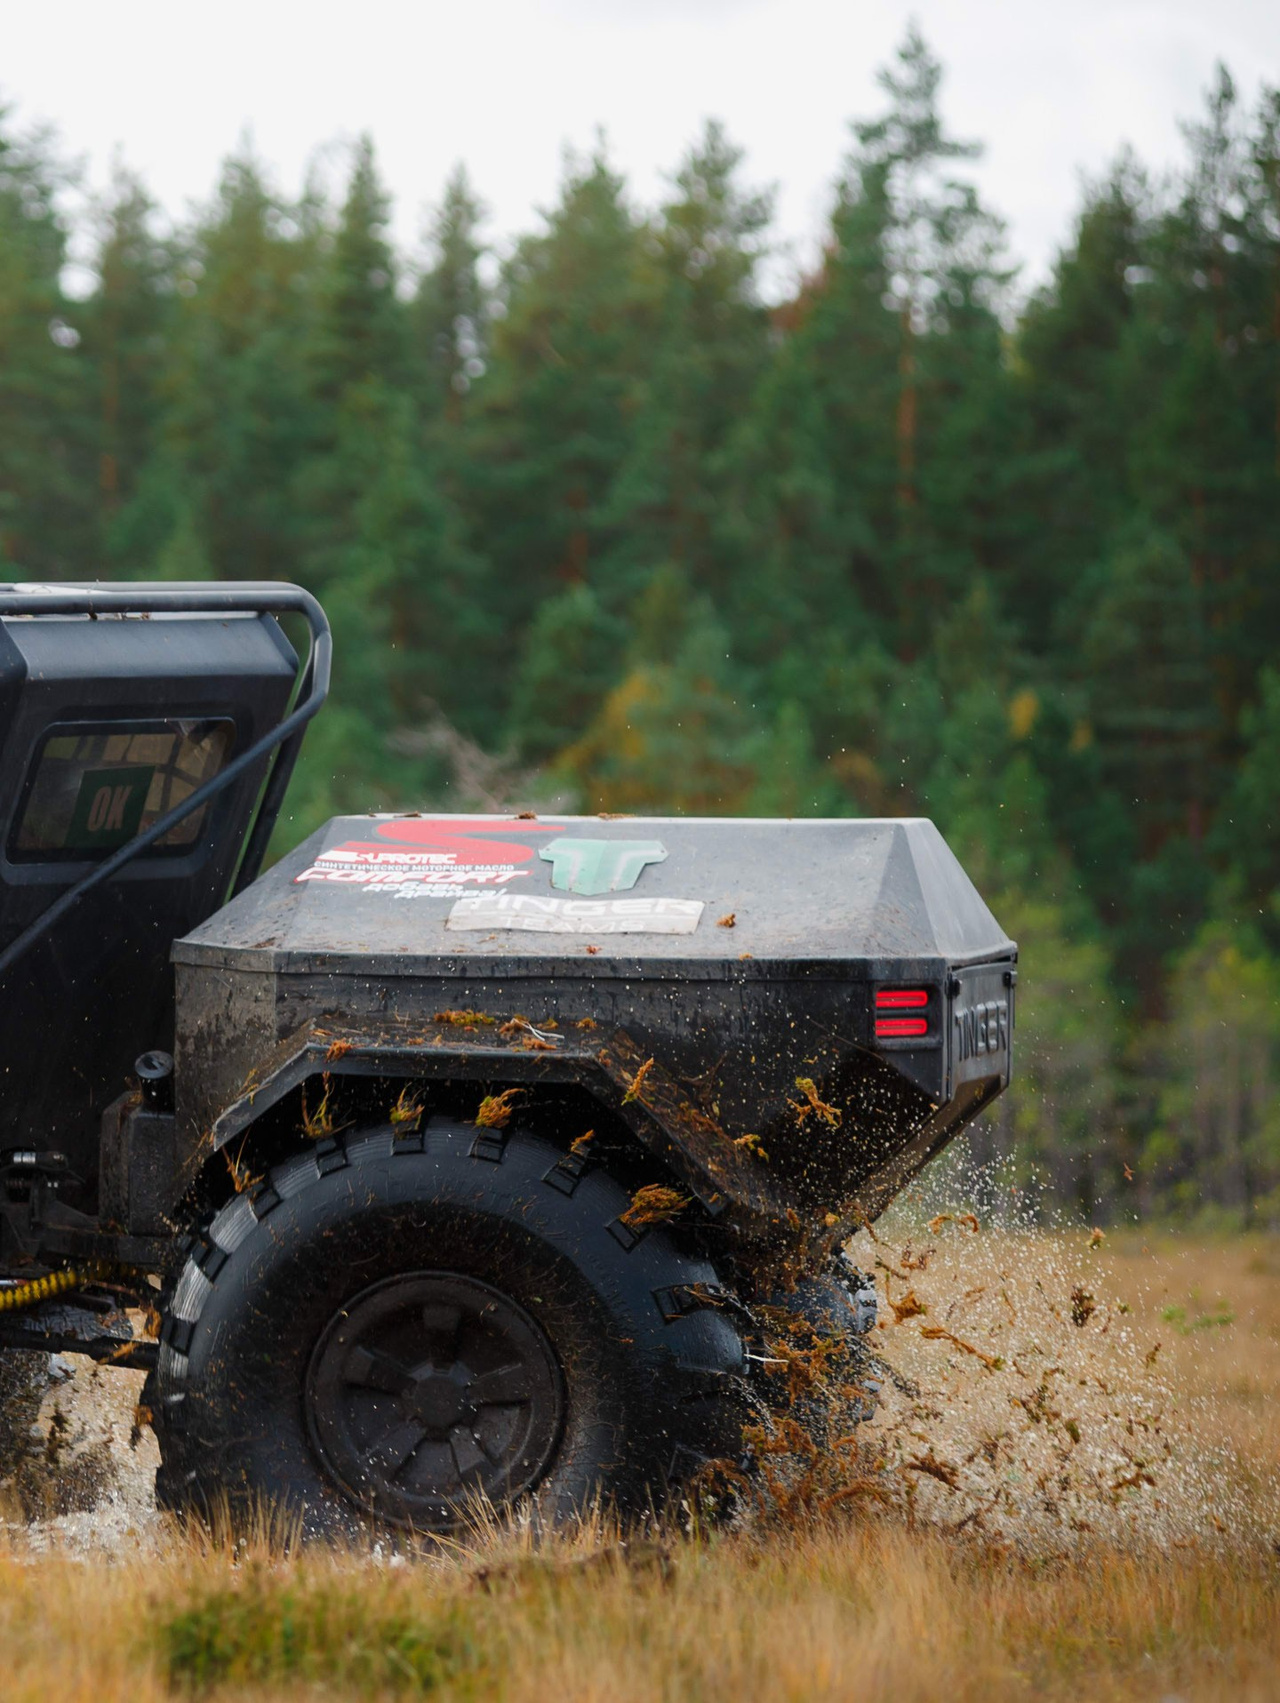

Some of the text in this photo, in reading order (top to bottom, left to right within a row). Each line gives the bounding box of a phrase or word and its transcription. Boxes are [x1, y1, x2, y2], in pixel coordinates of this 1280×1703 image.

[295, 866, 531, 884] COMFORT
[313, 861, 515, 872] СИНТЕТИЧЕСКОЕ МОТОРНОЕ МАСЛО
[458, 896, 697, 916] TINGER
[503, 915, 646, 933] TEAMS
